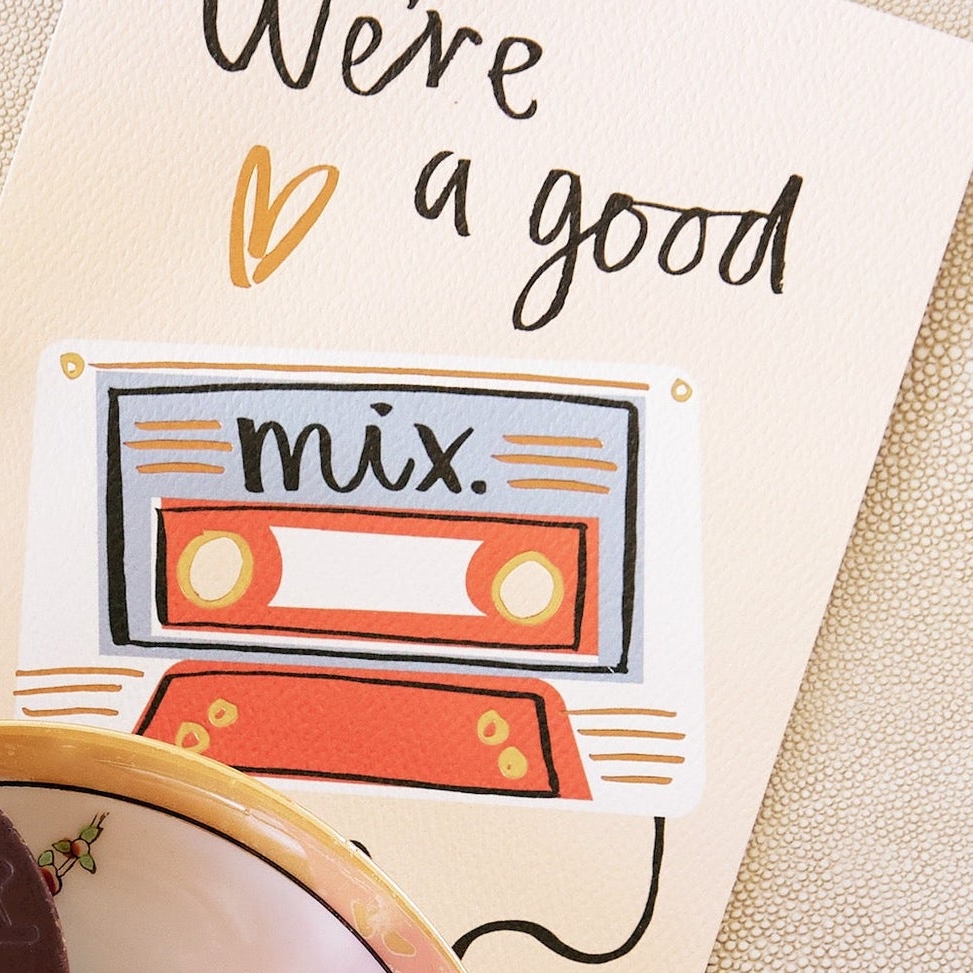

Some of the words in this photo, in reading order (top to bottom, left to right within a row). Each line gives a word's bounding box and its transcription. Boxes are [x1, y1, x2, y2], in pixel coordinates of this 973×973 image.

[414, 150, 472, 237] a
[513, 168, 804, 331] good
[237, 402, 487, 494] mix.
